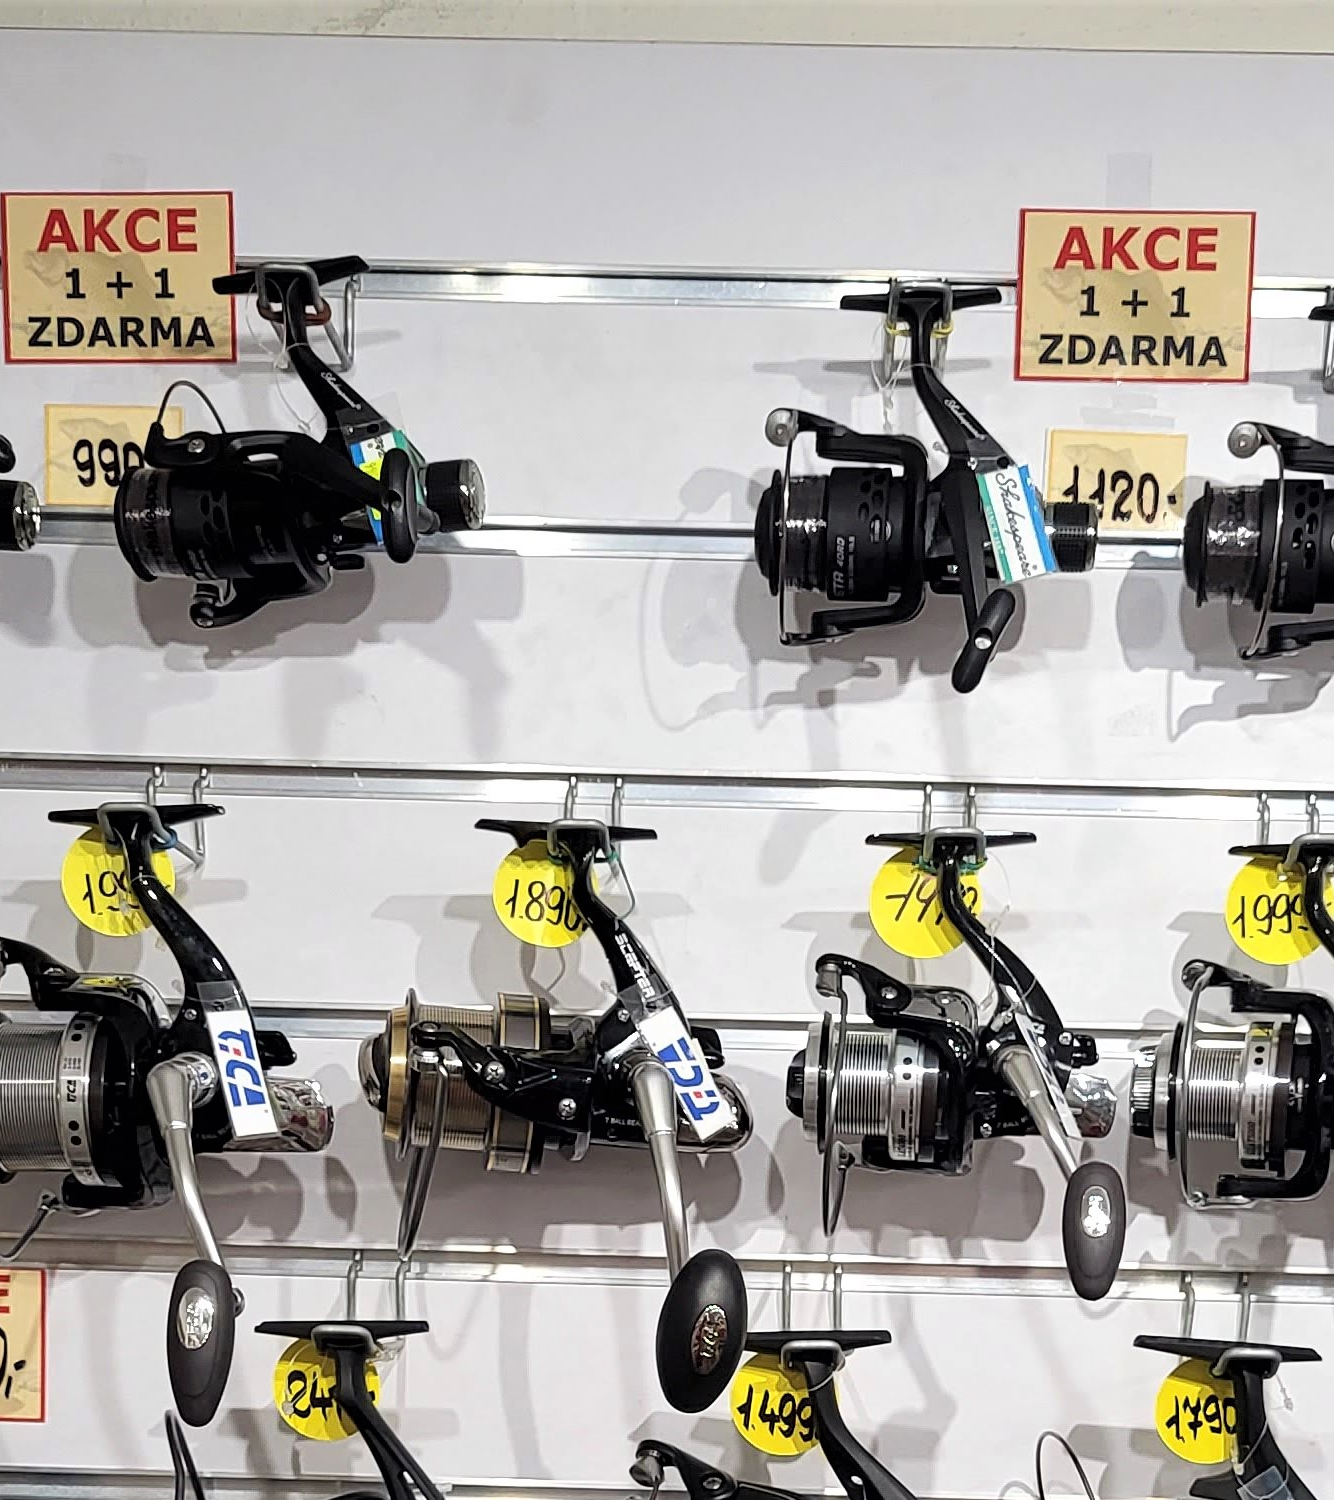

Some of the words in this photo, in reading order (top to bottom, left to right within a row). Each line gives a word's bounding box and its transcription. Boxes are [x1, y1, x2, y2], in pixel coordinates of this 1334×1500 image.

[38, 207, 198, 254] AKCE
[1055, 225, 1219, 272] AKCE
[65, 267, 84, 300] 1
[154, 267, 175, 301] 1
[1078, 286, 1098, 318] 1
[1170, 287, 1190, 319] 1
[27, 315, 215, 351] ZDARMA
[1038, 333, 1228, 368] ZDARMA
[995, 470, 1034, 579] Shakespeare
